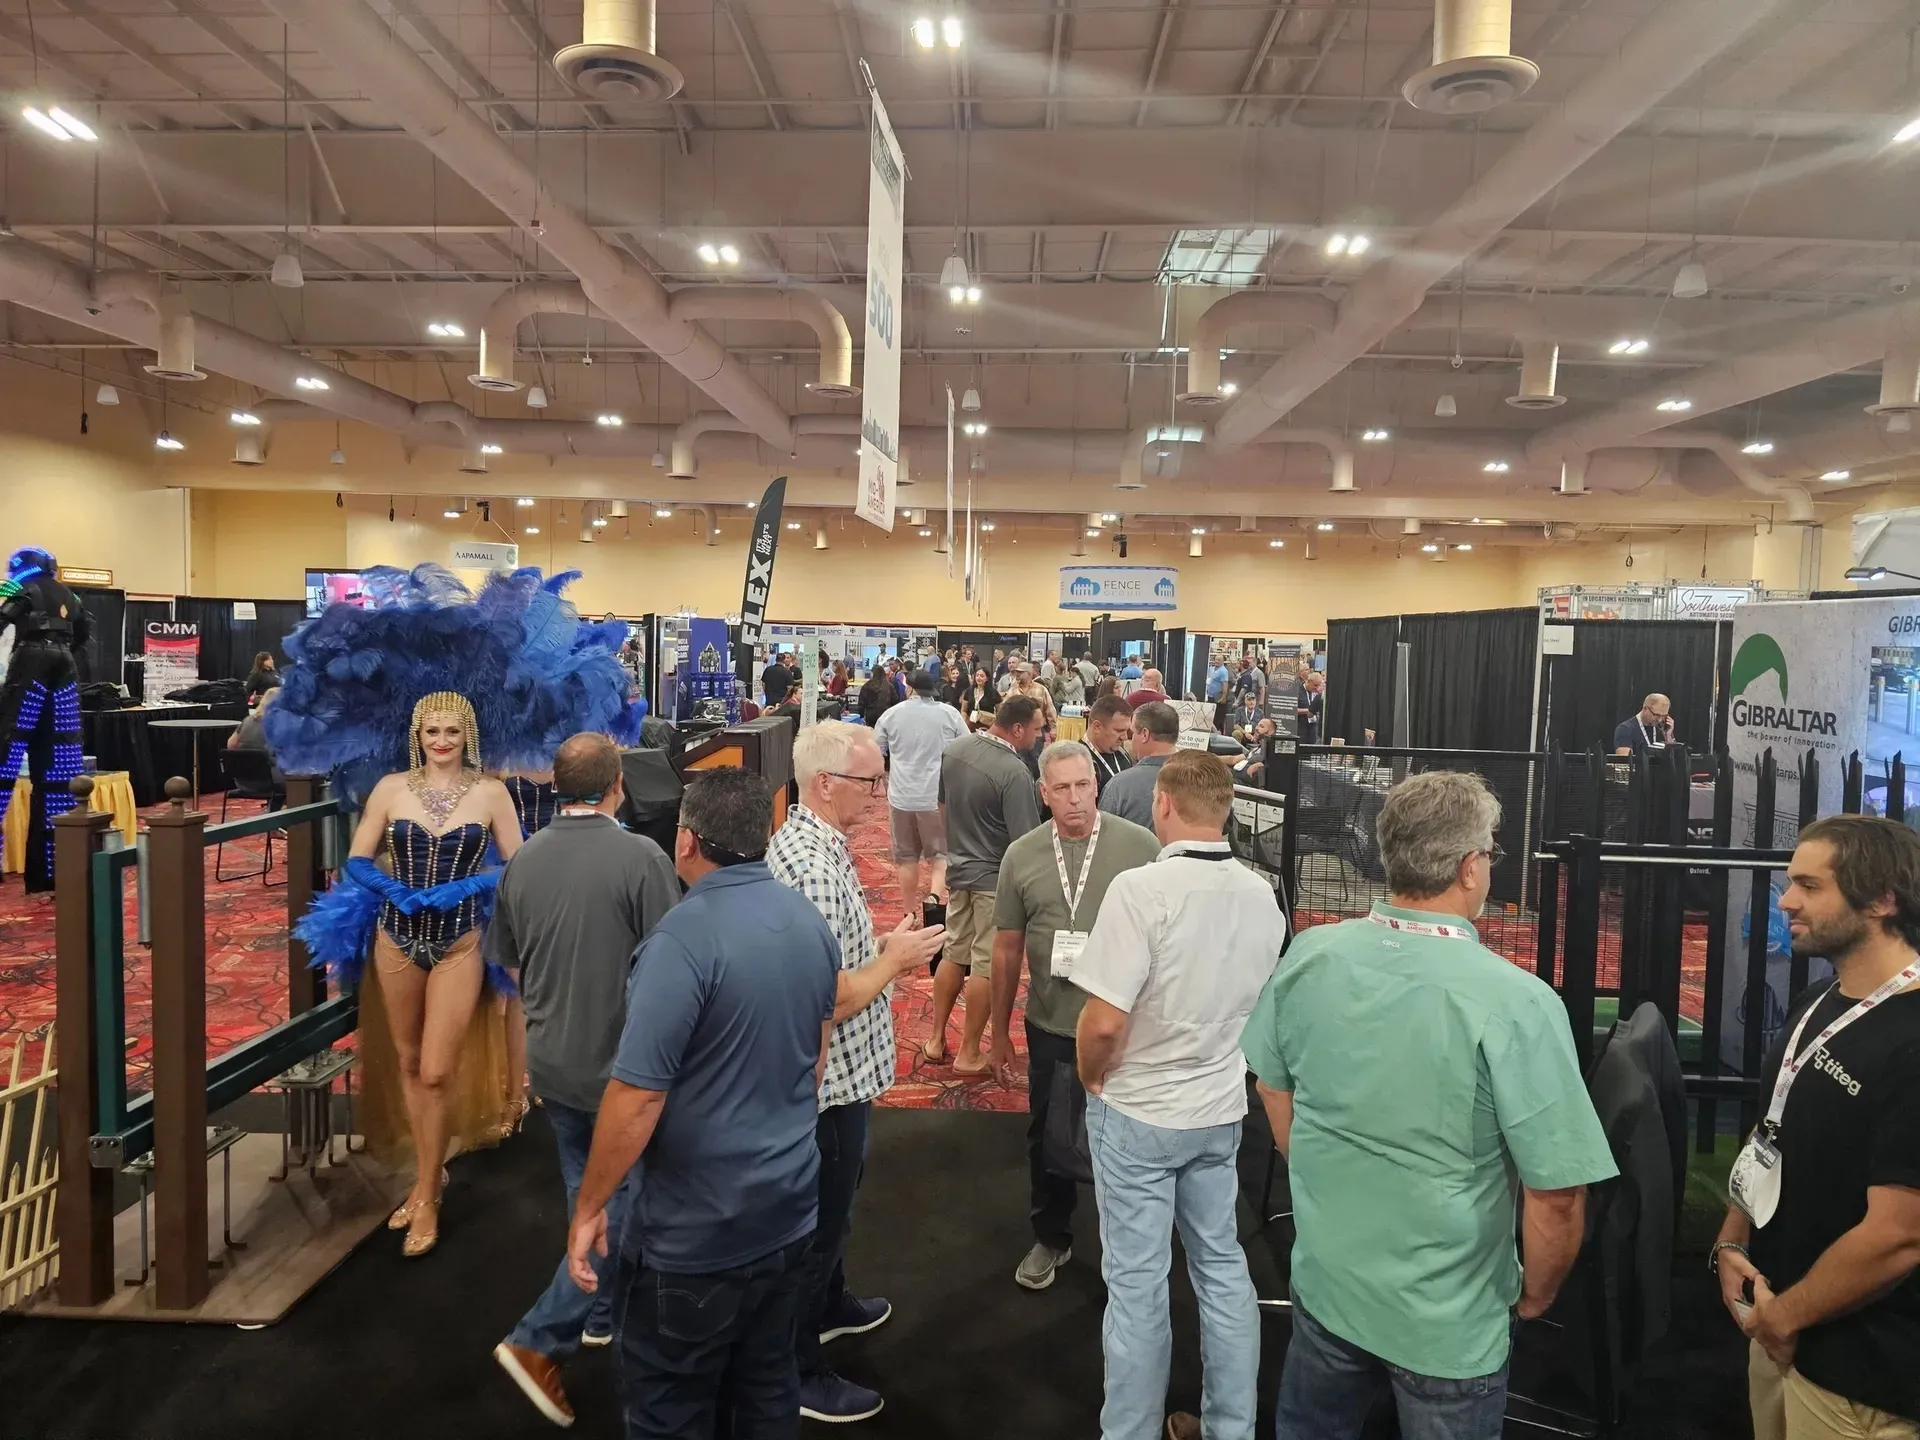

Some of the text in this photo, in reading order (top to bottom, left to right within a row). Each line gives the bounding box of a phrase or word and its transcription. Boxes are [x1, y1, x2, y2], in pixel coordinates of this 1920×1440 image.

[869, 266, 892, 350] 500
[760, 523, 770, 554] WHAT'S
[765, 534, 773, 556] NEXT
[1104, 581, 1141, 590] FENCE
[741, 553, 772, 646] FLEX
[1676, 588, 1744, 614] Southwest
[147, 622, 197, 635] CMM
[1733, 700, 1837, 736] GIBRALTAR
[1748, 731, 1836, 749] the power of innovation
[1406, 925, 1432, 933] AMERICA
[1823, 1057, 1862, 1096] titeg
